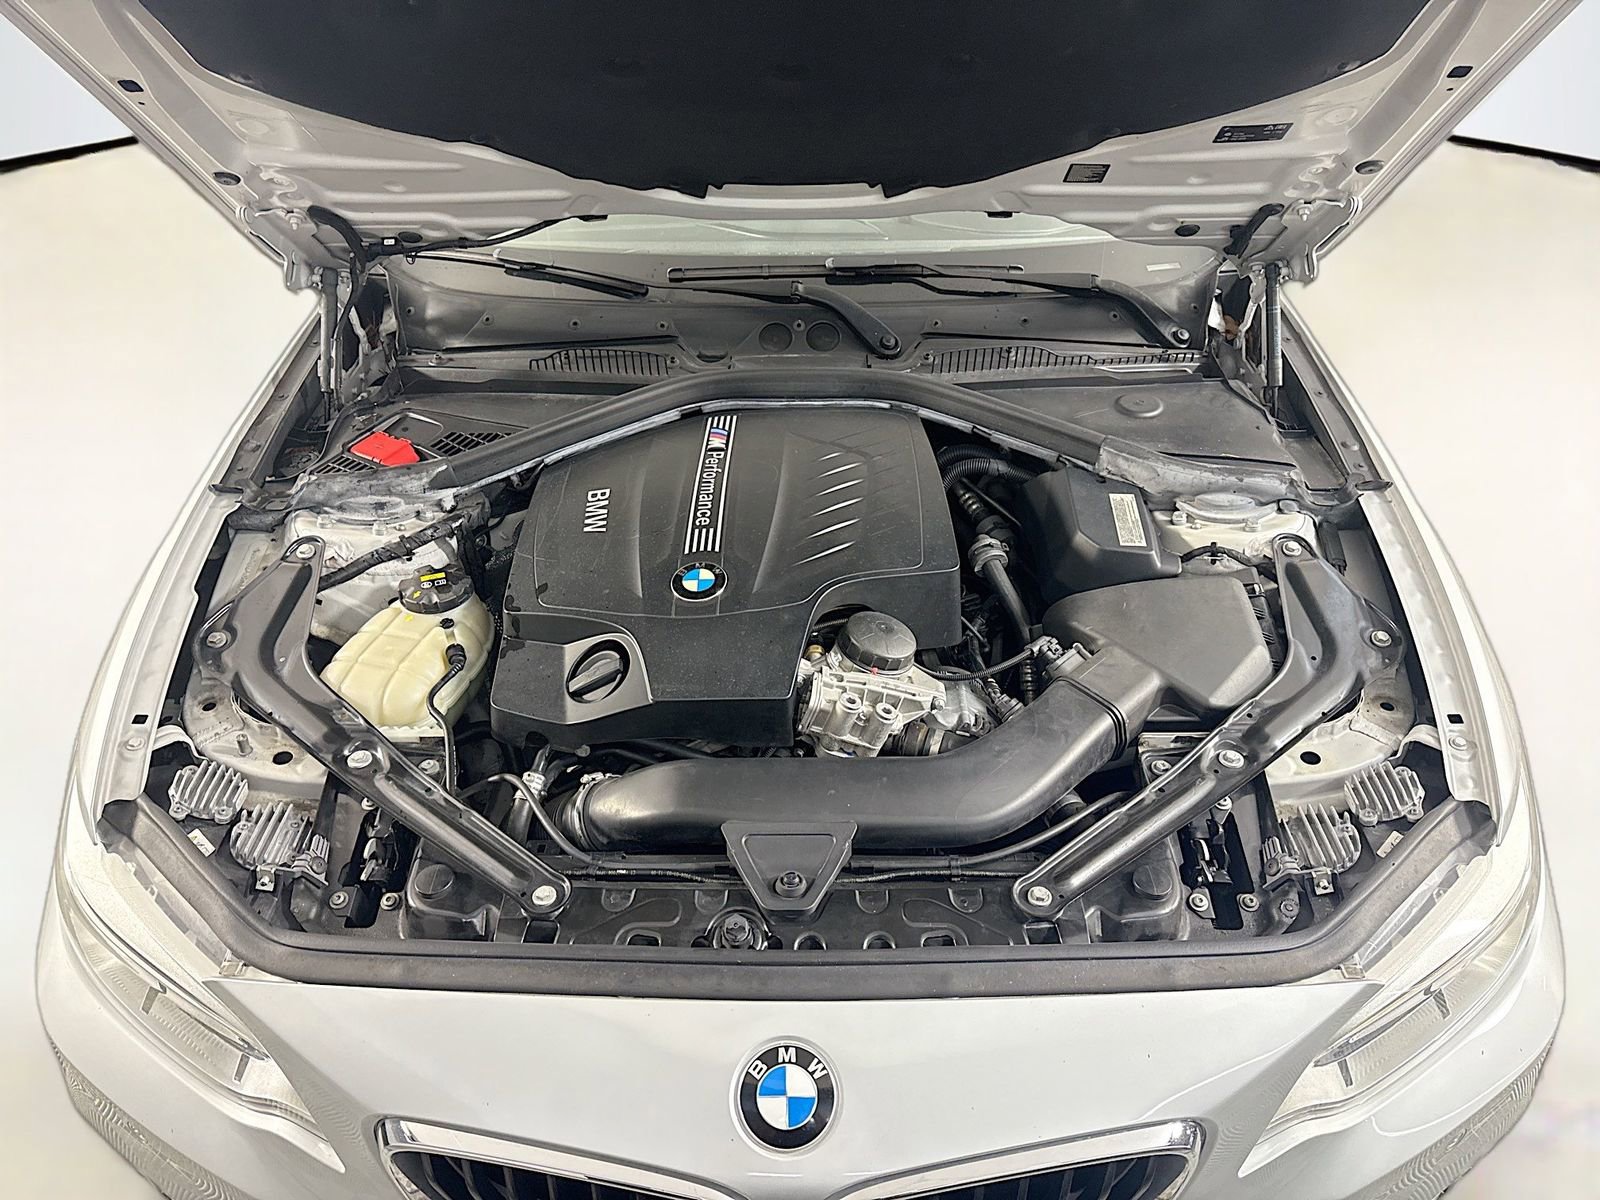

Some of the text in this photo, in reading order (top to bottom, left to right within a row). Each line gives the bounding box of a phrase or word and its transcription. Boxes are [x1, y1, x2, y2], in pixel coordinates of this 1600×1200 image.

[695, 451, 725, 526] Performance
[583, 488, 611, 533] BMW
[678, 562, 722, 576] BMW
[747, 1046, 828, 1080] BMW
